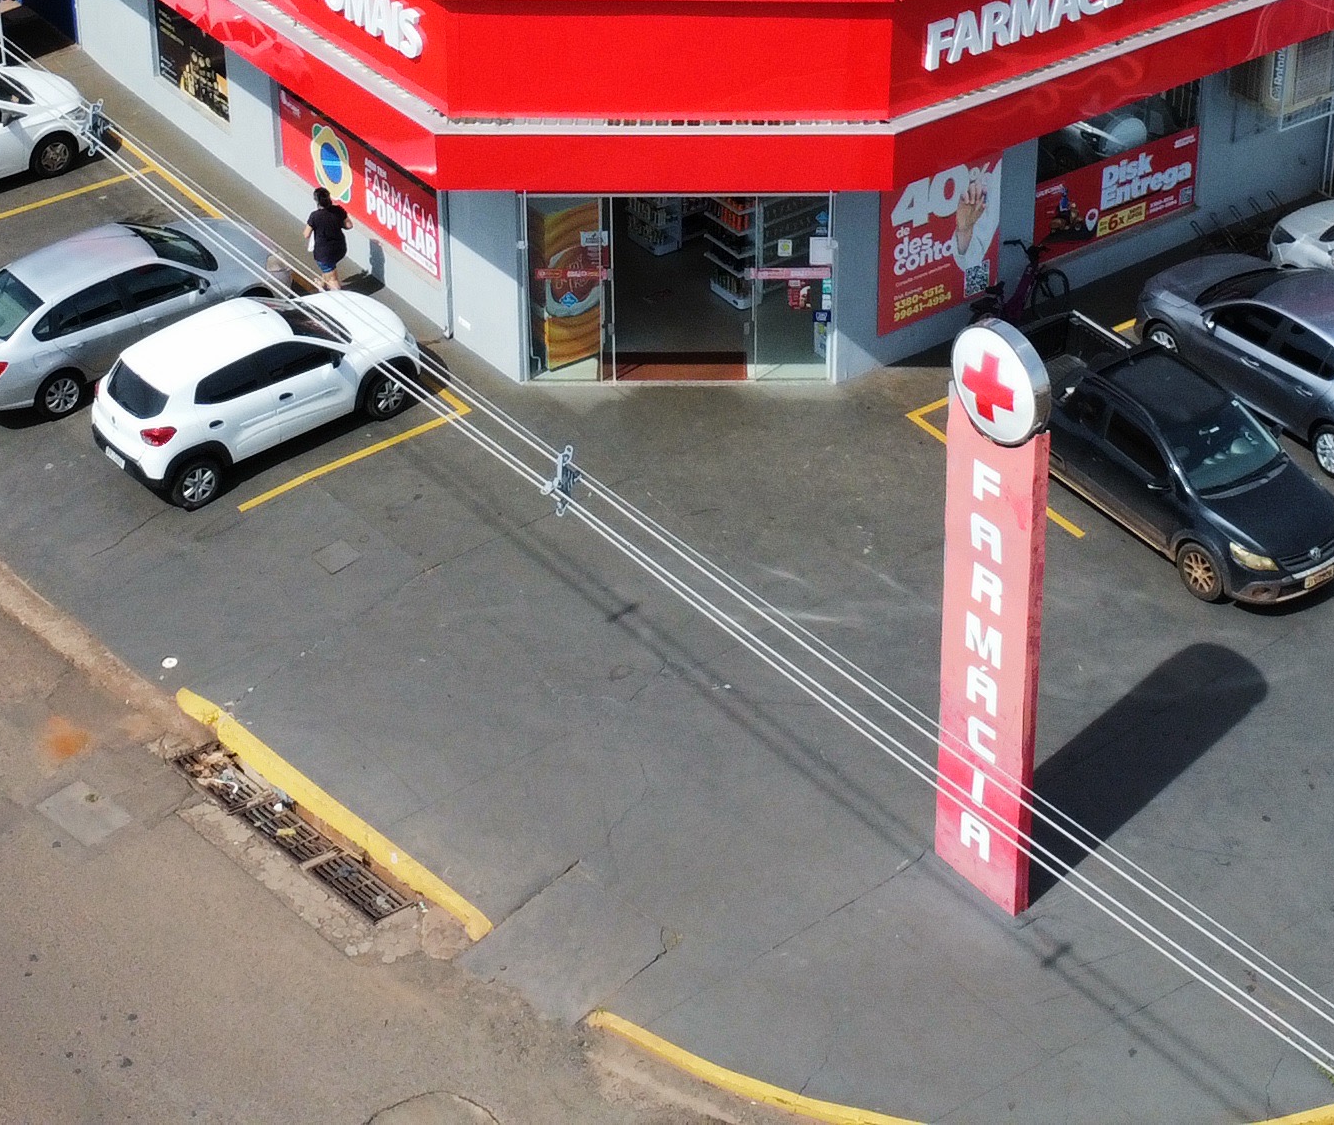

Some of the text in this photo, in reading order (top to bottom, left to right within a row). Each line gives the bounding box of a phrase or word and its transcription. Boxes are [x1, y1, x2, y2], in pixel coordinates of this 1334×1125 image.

[1100, 161, 1192, 211] Entrega
[1102, 152, 1154, 189] Disk
[365, 167, 436, 237] FARMÁCIA
[366, 189, 438, 264] POPULAR
[894, 230, 934, 262] des
[895, 225, 910, 238] de
[960, 459, 1002, 863] FARMÁCIA
